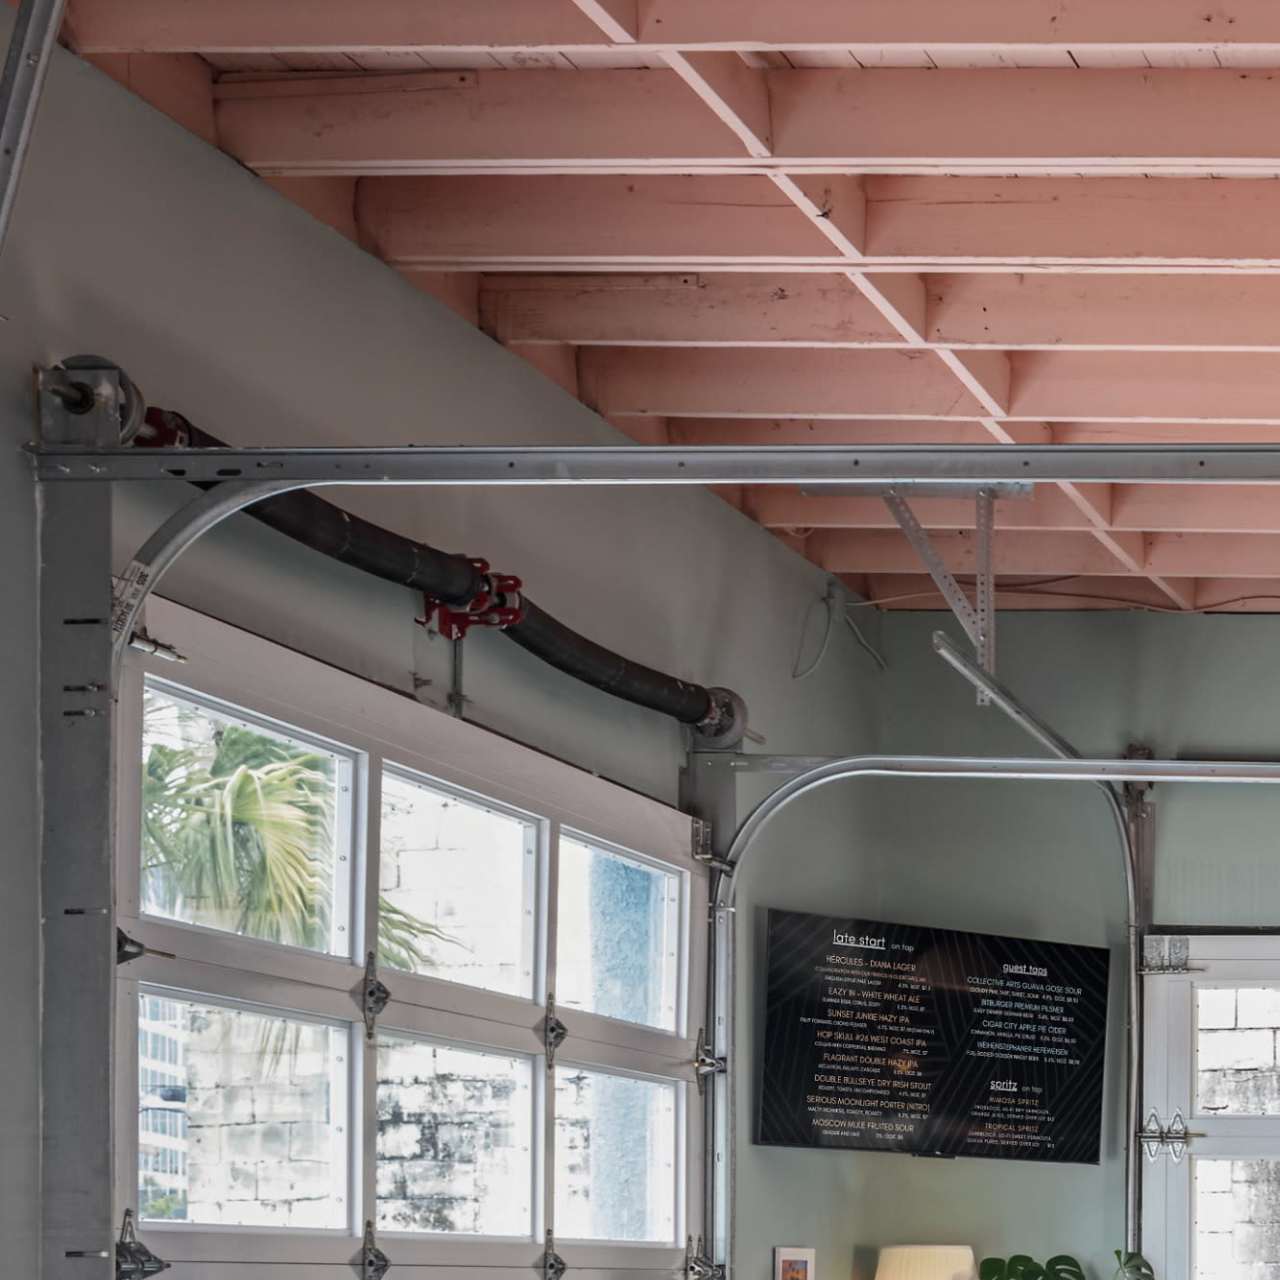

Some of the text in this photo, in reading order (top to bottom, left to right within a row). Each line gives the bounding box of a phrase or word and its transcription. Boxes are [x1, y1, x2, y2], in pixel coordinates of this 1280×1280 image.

[833, 929, 886, 949] late start
[891, 943, 915, 953] on tap
[826, 954, 864, 967] HERCULES
[870, 959, 892, 970] DIANA
[893, 961, 917, 972] LAGER
[1002, 963, 1048, 977] guest taps
[967, 976, 1005, 987] COLLECTIVE
[1005, 980, 1022, 989] ARTS
[1022, 982, 1045, 991] GUAVA
[1045, 984, 1065, 994] GOSE
[1064, 987, 1082, 996] SOUR
[828, 986, 847, 997] EAZY
[848, 988, 857, 997] IN
[861, 991, 884, 1001] WHITE
[883, 992, 907, 1003] WHEAT
[907, 994, 921, 1004] ALE
[981, 998, 1014, 1009] BITBURGER
[1041, 1004, 1064, 1014] PILSNER
[827, 1008, 855, 1020] SUNSET
[855, 1011, 880, 1021] JUNKIE
[879, 1013, 898, 1023] HAZY
[898, 1015, 911, 1024] IPA
[982, 1019, 1003, 1029] CIGAR
[1003, 1021, 1018, 1031] CITY
[1018, 1023, 1038, 1032] APPLE
[1037, 1025, 1047, 1033] PIE
[1047, 1026, 1067, 1035] CIDER
[816, 1029, 833, 1039] HOP
[833, 1031, 854, 1042] SKULL
[869, 1034, 890, 1044] WEST
[890, 1036, 915, 1046] COAST
[915, 1038, 928, 1048] IPA
[823, 1052, 858, 1064] FLAGRANT
[859, 1055, 886, 1066] DOUBLE
[887, 1058, 906, 1068] HAZY
[814, 1073, 932, 1091] DOUBLE BULLSEYE DRY IRISH STOUT
[990, 1080, 1018, 1092] spritz
[806, 1095, 837, 1106] SERIOUS
[837, 1097, 880, 1108] MOONLIGHT
[880, 1100, 906, 1111] PORTER
[1017, 1097, 1040, 1106] SPRITZ
[812, 1119, 915, 1133] MOSCOW MULE FRUITED SOUR
[985, 1122, 1040, 1133] TROPICAL SPRITZ
